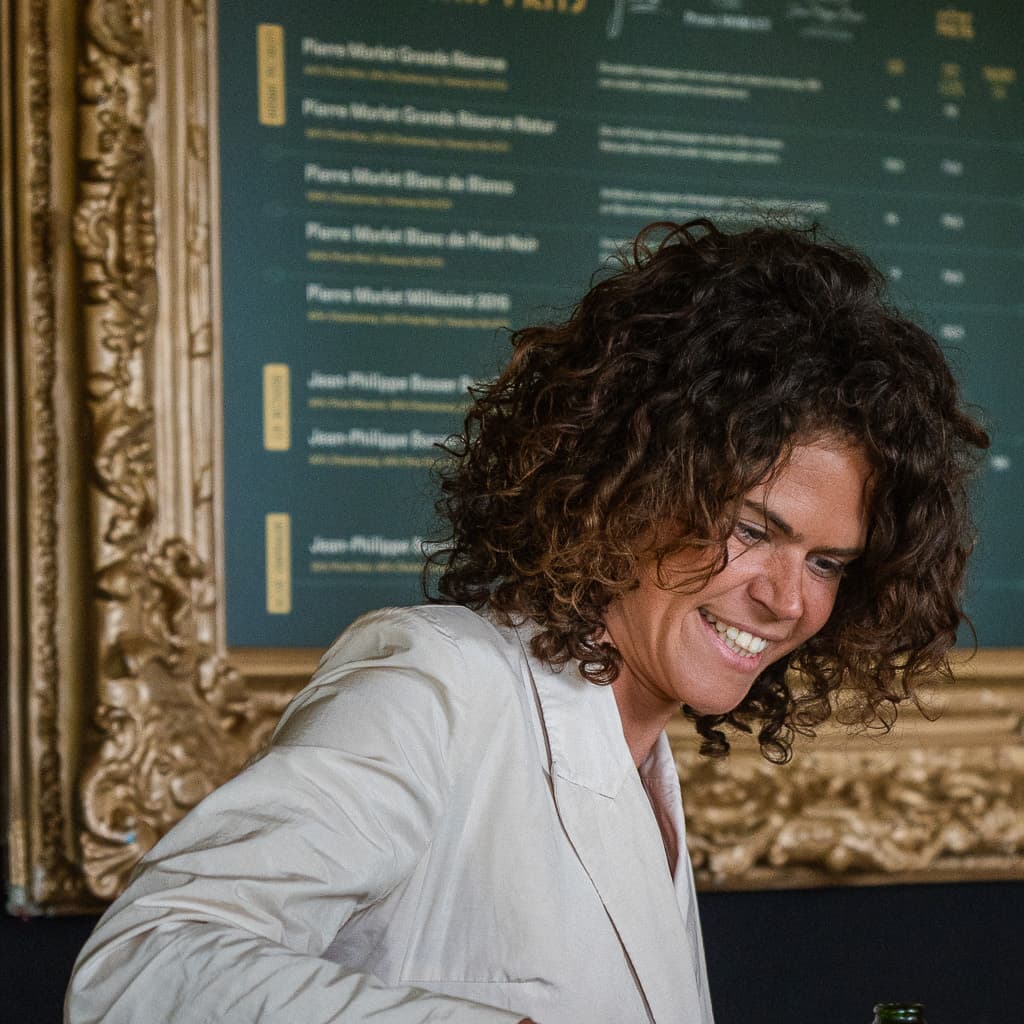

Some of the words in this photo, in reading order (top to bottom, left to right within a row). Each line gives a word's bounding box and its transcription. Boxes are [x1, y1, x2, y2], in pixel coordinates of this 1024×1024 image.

[304, 163, 350, 183] Pierre
[446, 174, 465, 191] de
[304, 221, 350, 240] Pierre
[446, 230, 466, 248] de
[305, 283, 351, 302] Pierre
